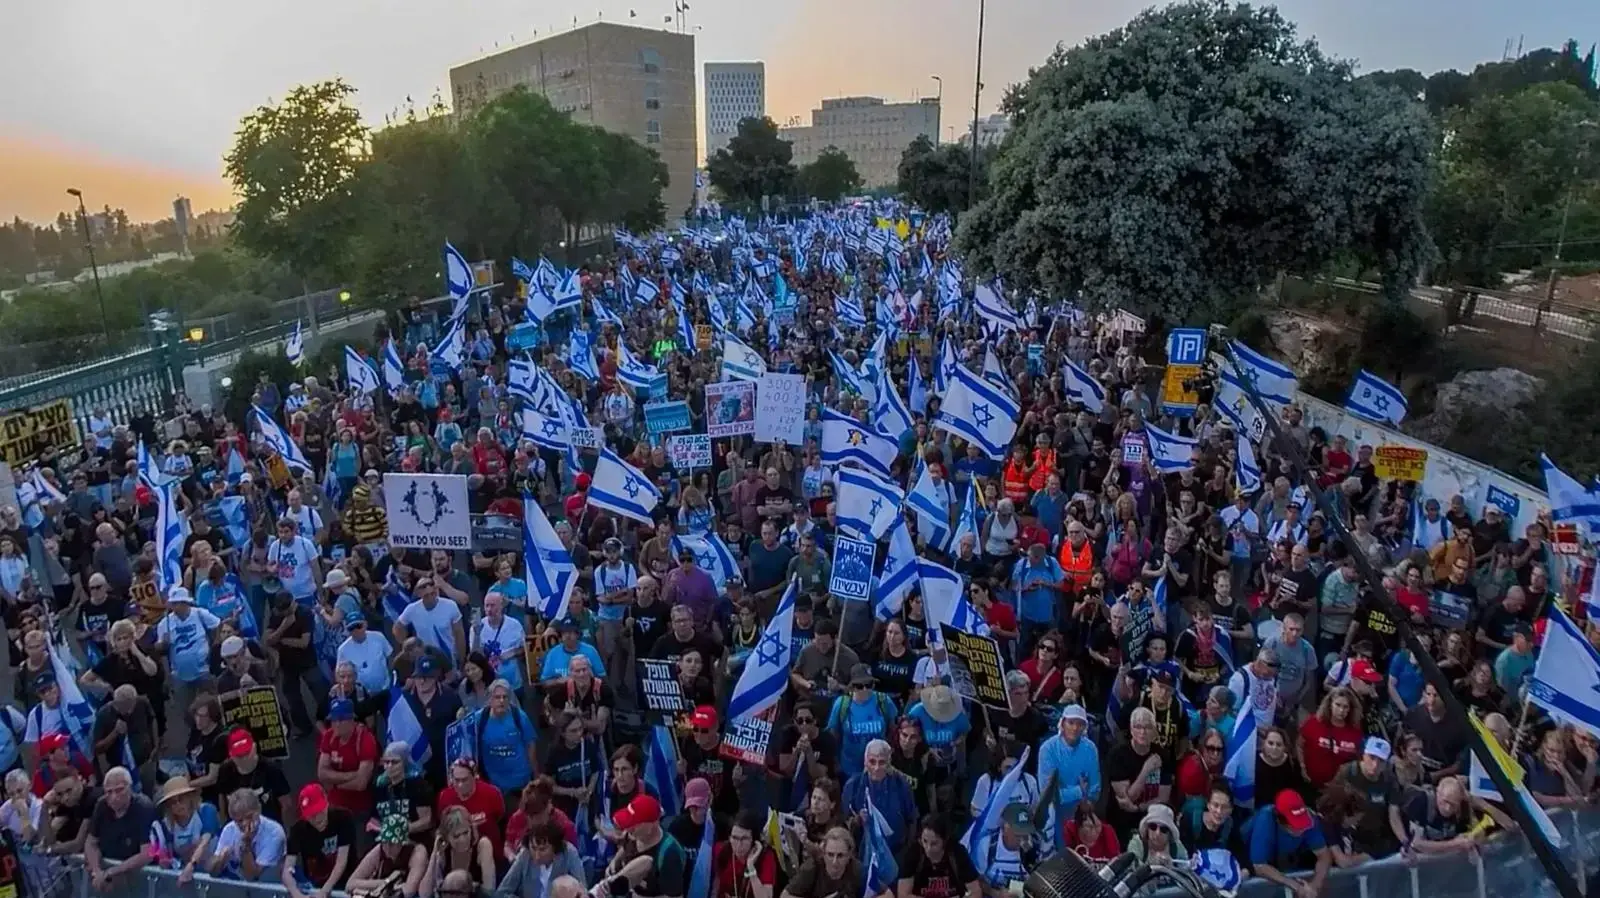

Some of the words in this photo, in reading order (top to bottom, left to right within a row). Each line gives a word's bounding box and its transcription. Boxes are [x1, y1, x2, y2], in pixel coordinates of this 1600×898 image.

[392, 535, 414, 545] WHAT
[416, 535, 428, 545] DO
[429, 535, 446, 545] YOU
[448, 536, 467, 546] SEE?
[839, 540, 873, 555] בחירות
[642, 679, 681, 695] ממשלת
[646, 694, 683, 710] החורבן
[733, 723, 757, 740] גביר
[723, 733, 768, 755] הראשונה
